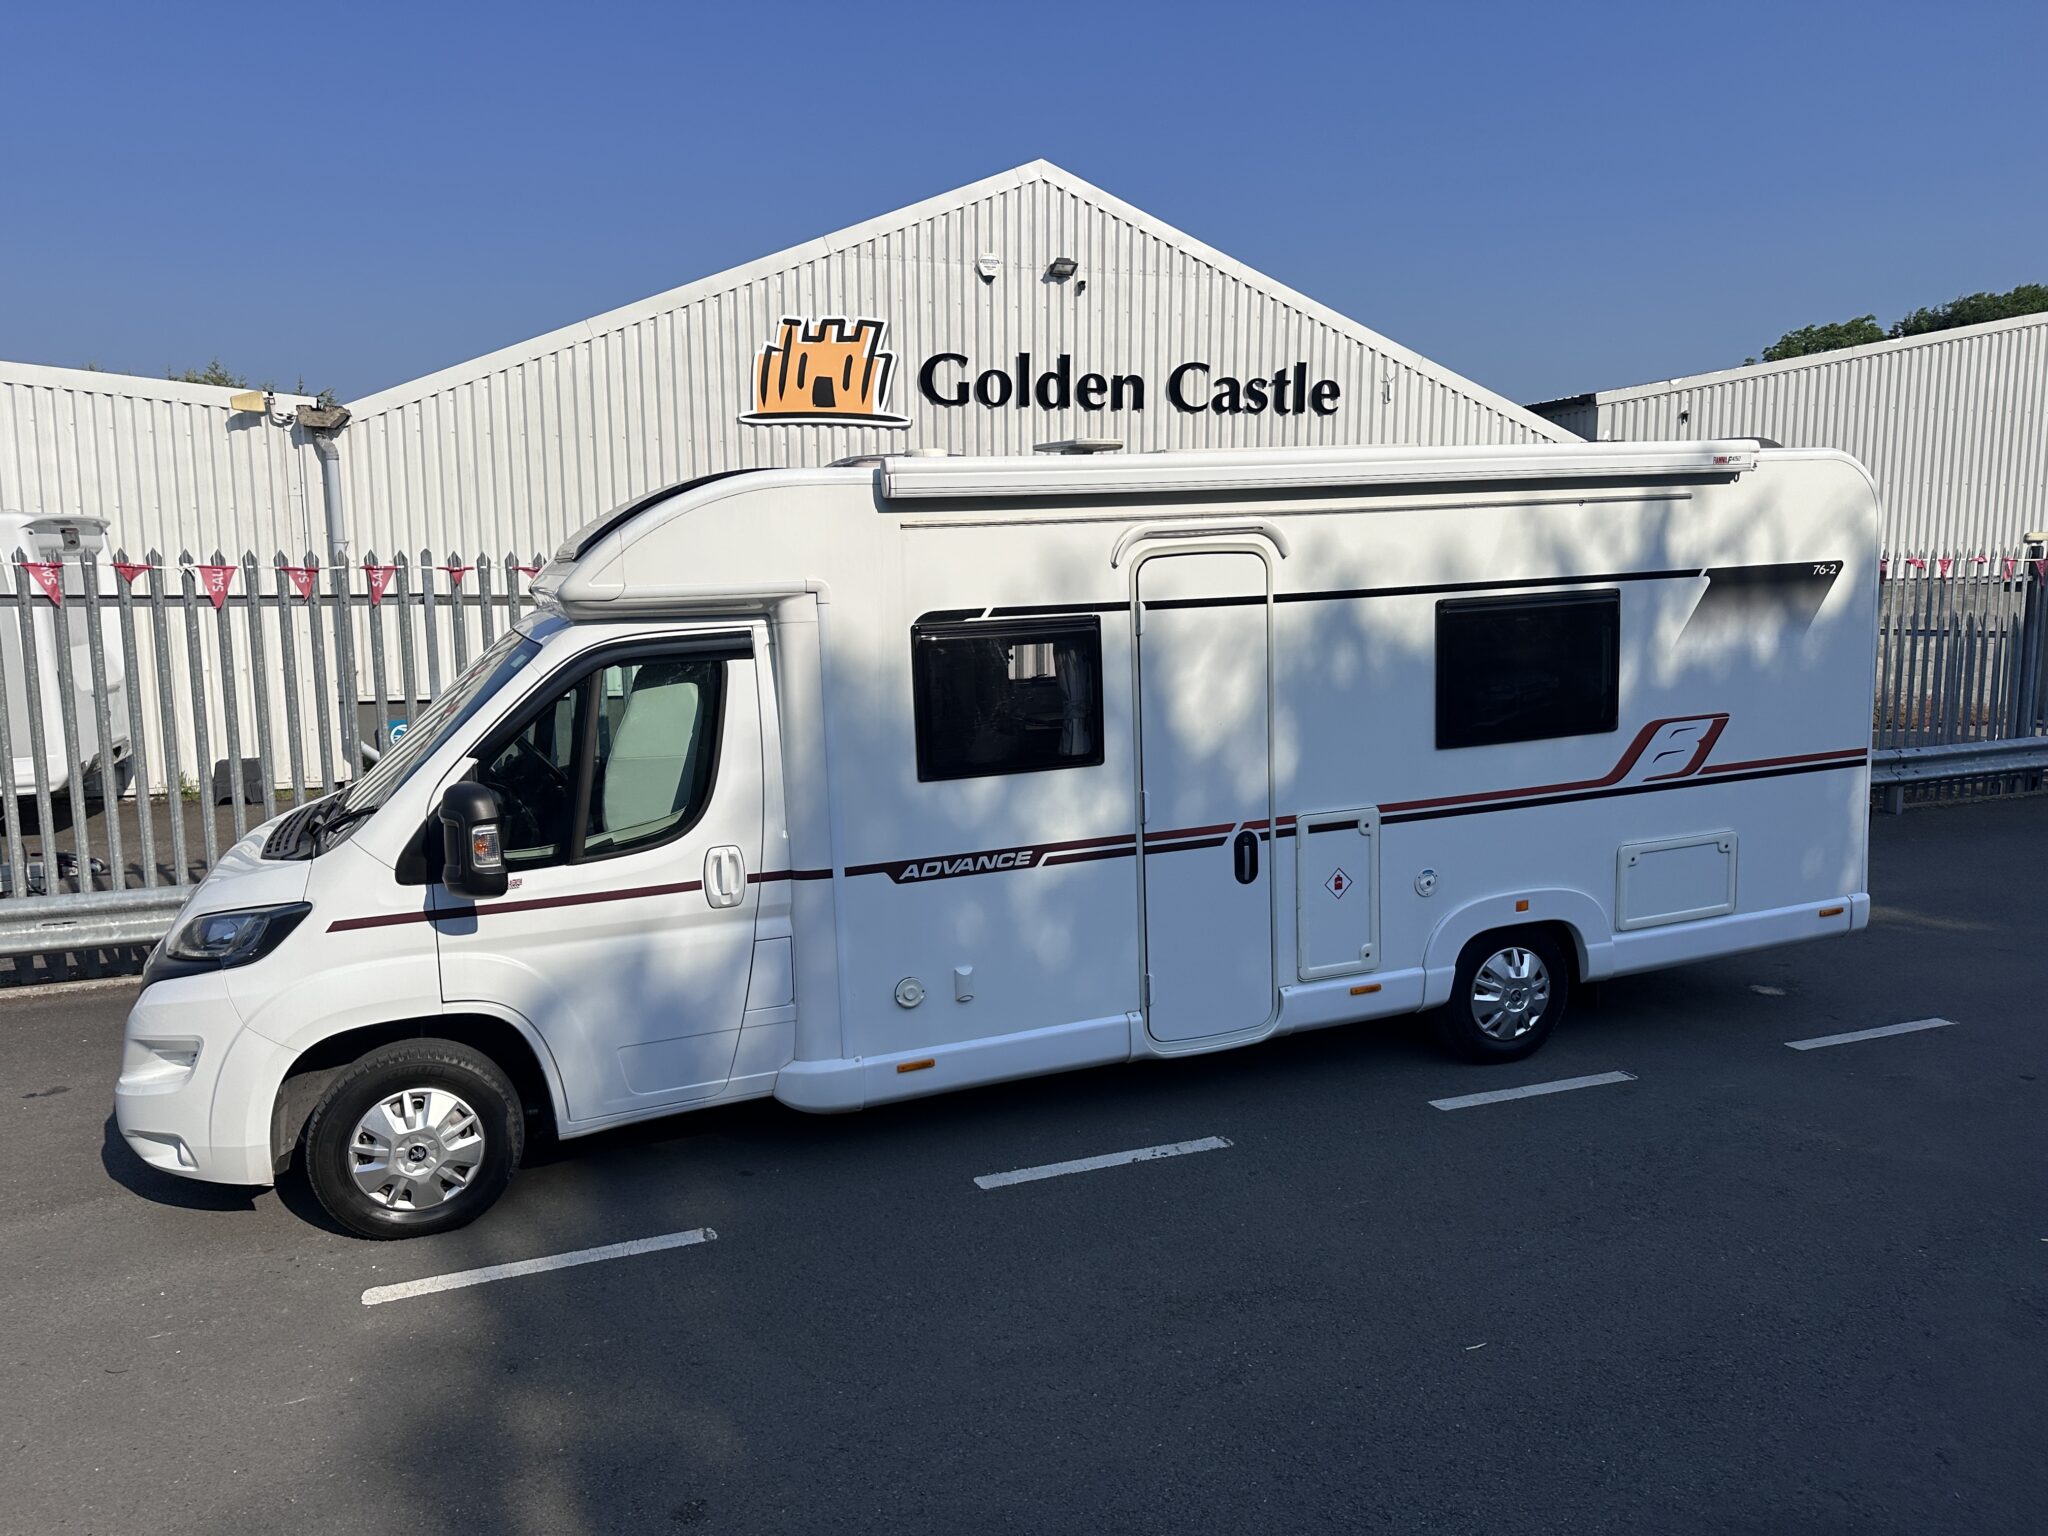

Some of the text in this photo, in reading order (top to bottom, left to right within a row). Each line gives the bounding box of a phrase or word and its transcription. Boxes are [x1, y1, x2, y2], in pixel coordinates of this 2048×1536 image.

[919, 353, 1341, 416] Golden Castle
[1813, 564, 1837, 576] 76-2
[899, 850, 1034, 880] ADVANCE
